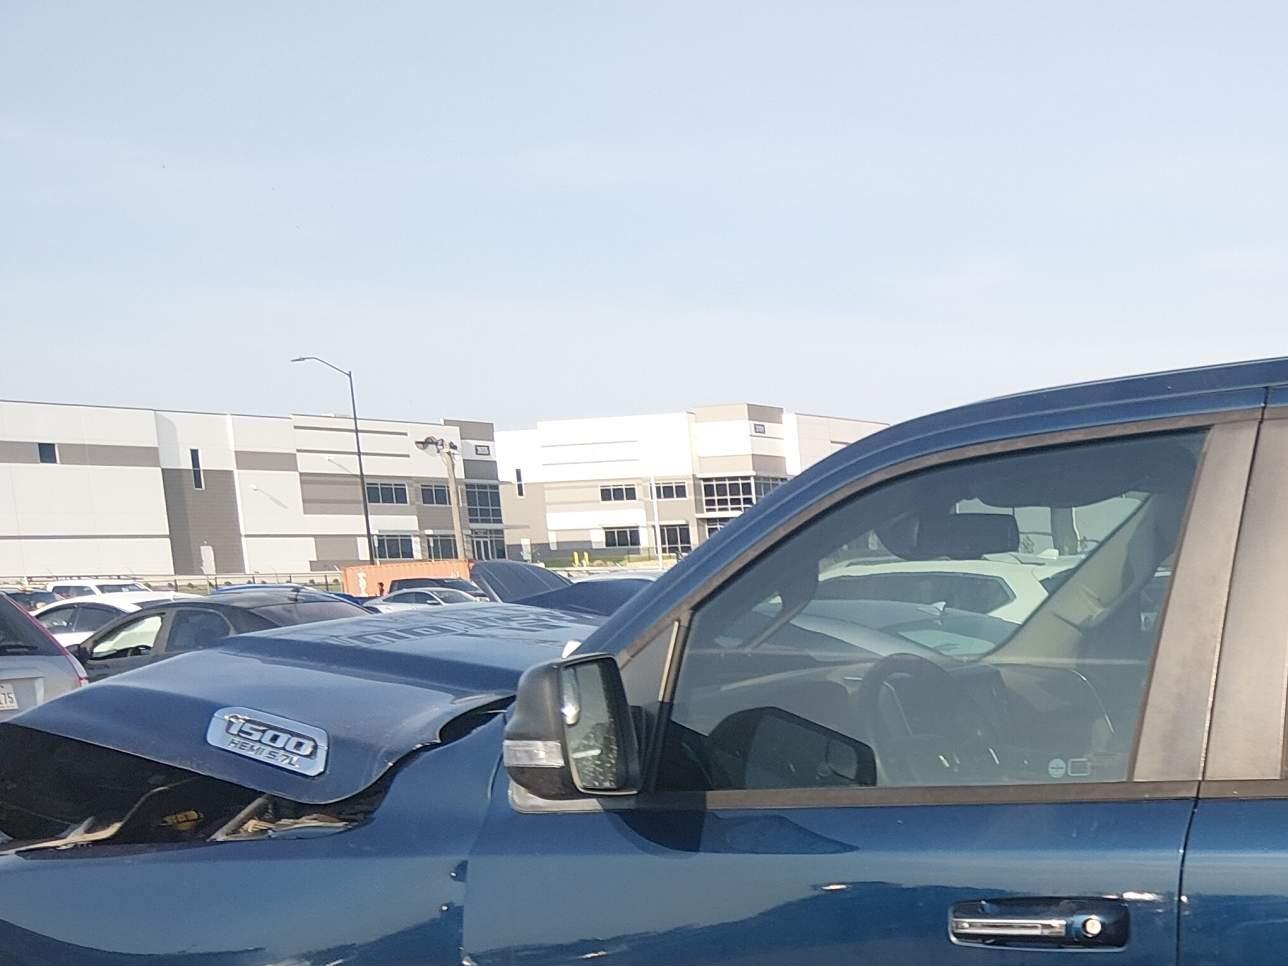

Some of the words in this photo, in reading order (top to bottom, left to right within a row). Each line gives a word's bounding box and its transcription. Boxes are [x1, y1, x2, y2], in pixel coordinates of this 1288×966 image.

[0, 691, 14, 704] 75
[224, 714, 317, 756] 1500
[227, 739, 264, 756] HEMI
[265, 748, 300, 767] 5.7L
